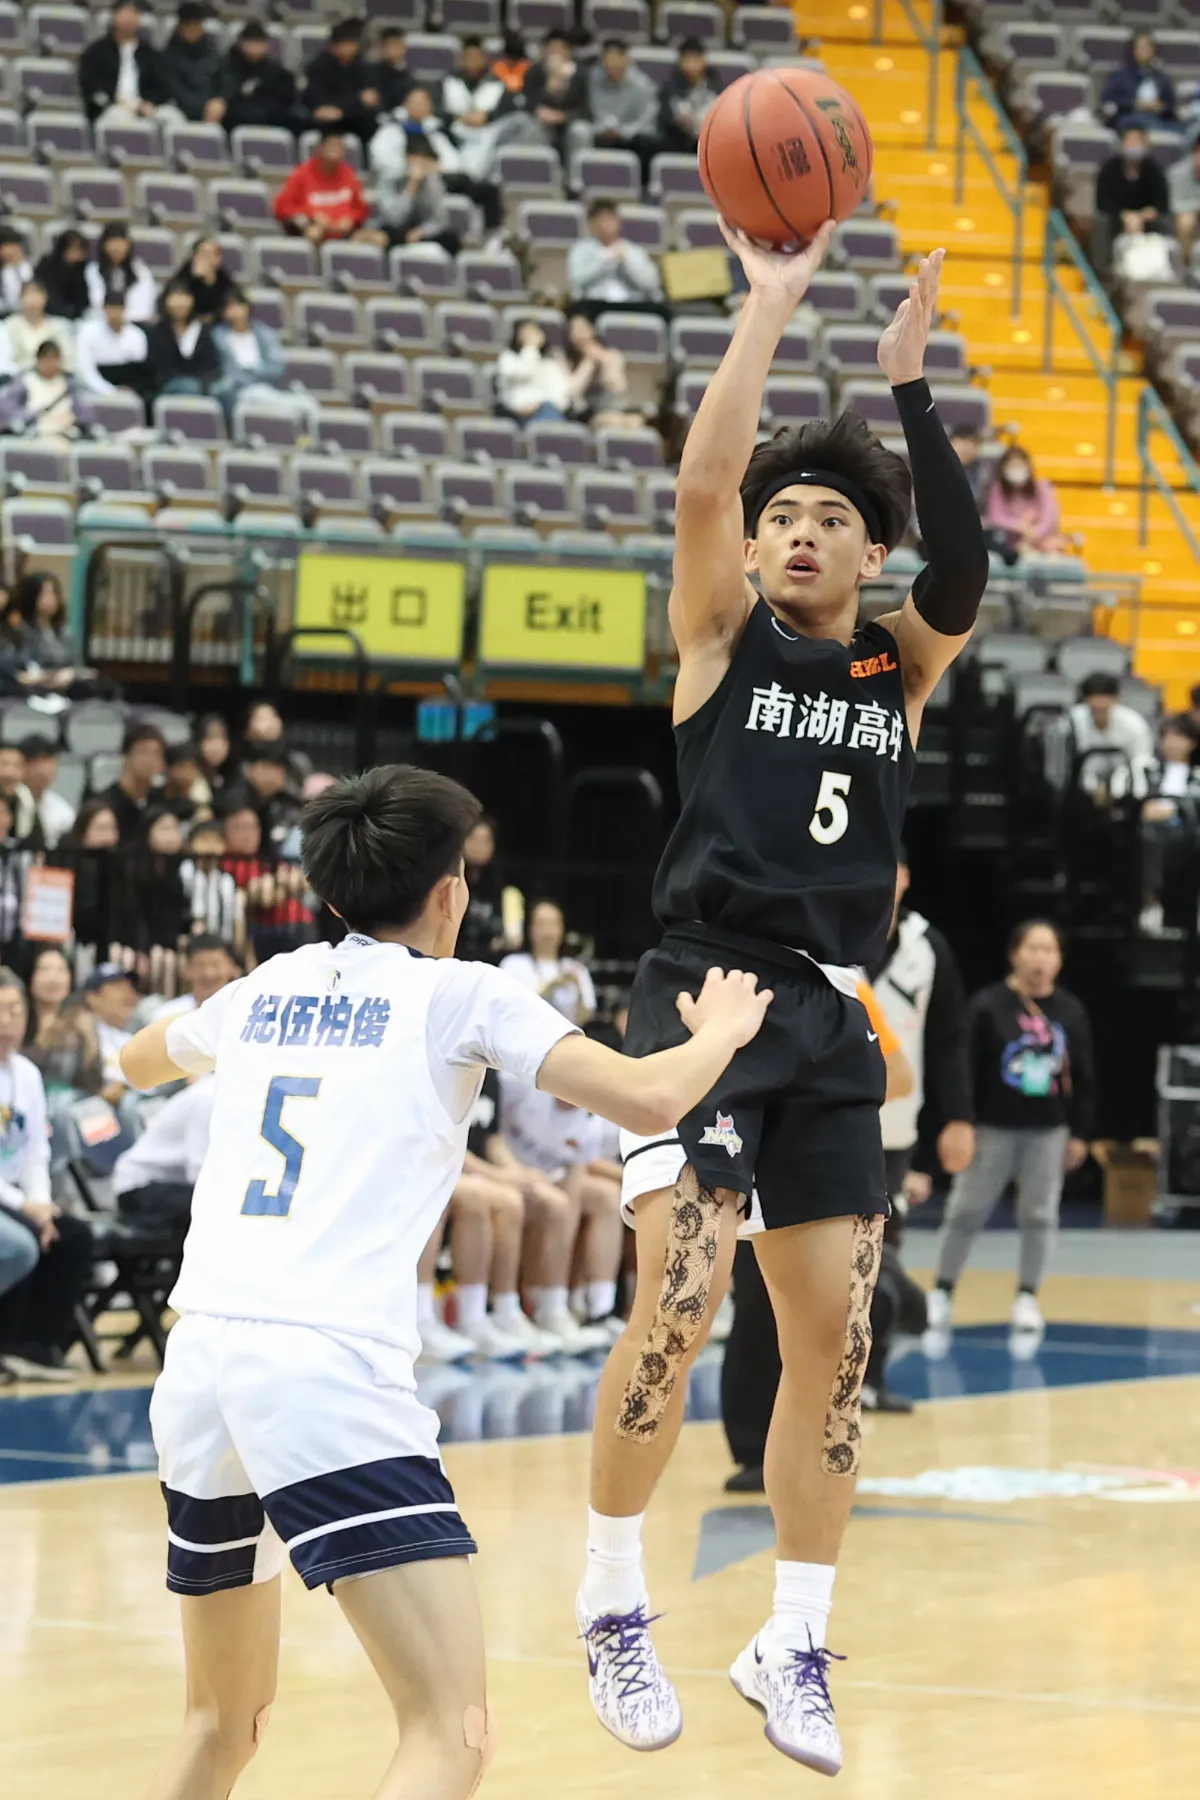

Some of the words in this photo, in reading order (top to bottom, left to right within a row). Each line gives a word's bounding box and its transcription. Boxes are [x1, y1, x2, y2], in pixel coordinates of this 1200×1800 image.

[330, 583, 428, 627] 出口
[525, 591, 603, 634] Exit
[808, 770, 852, 845] 5
[240, 1074, 323, 1218] 5
